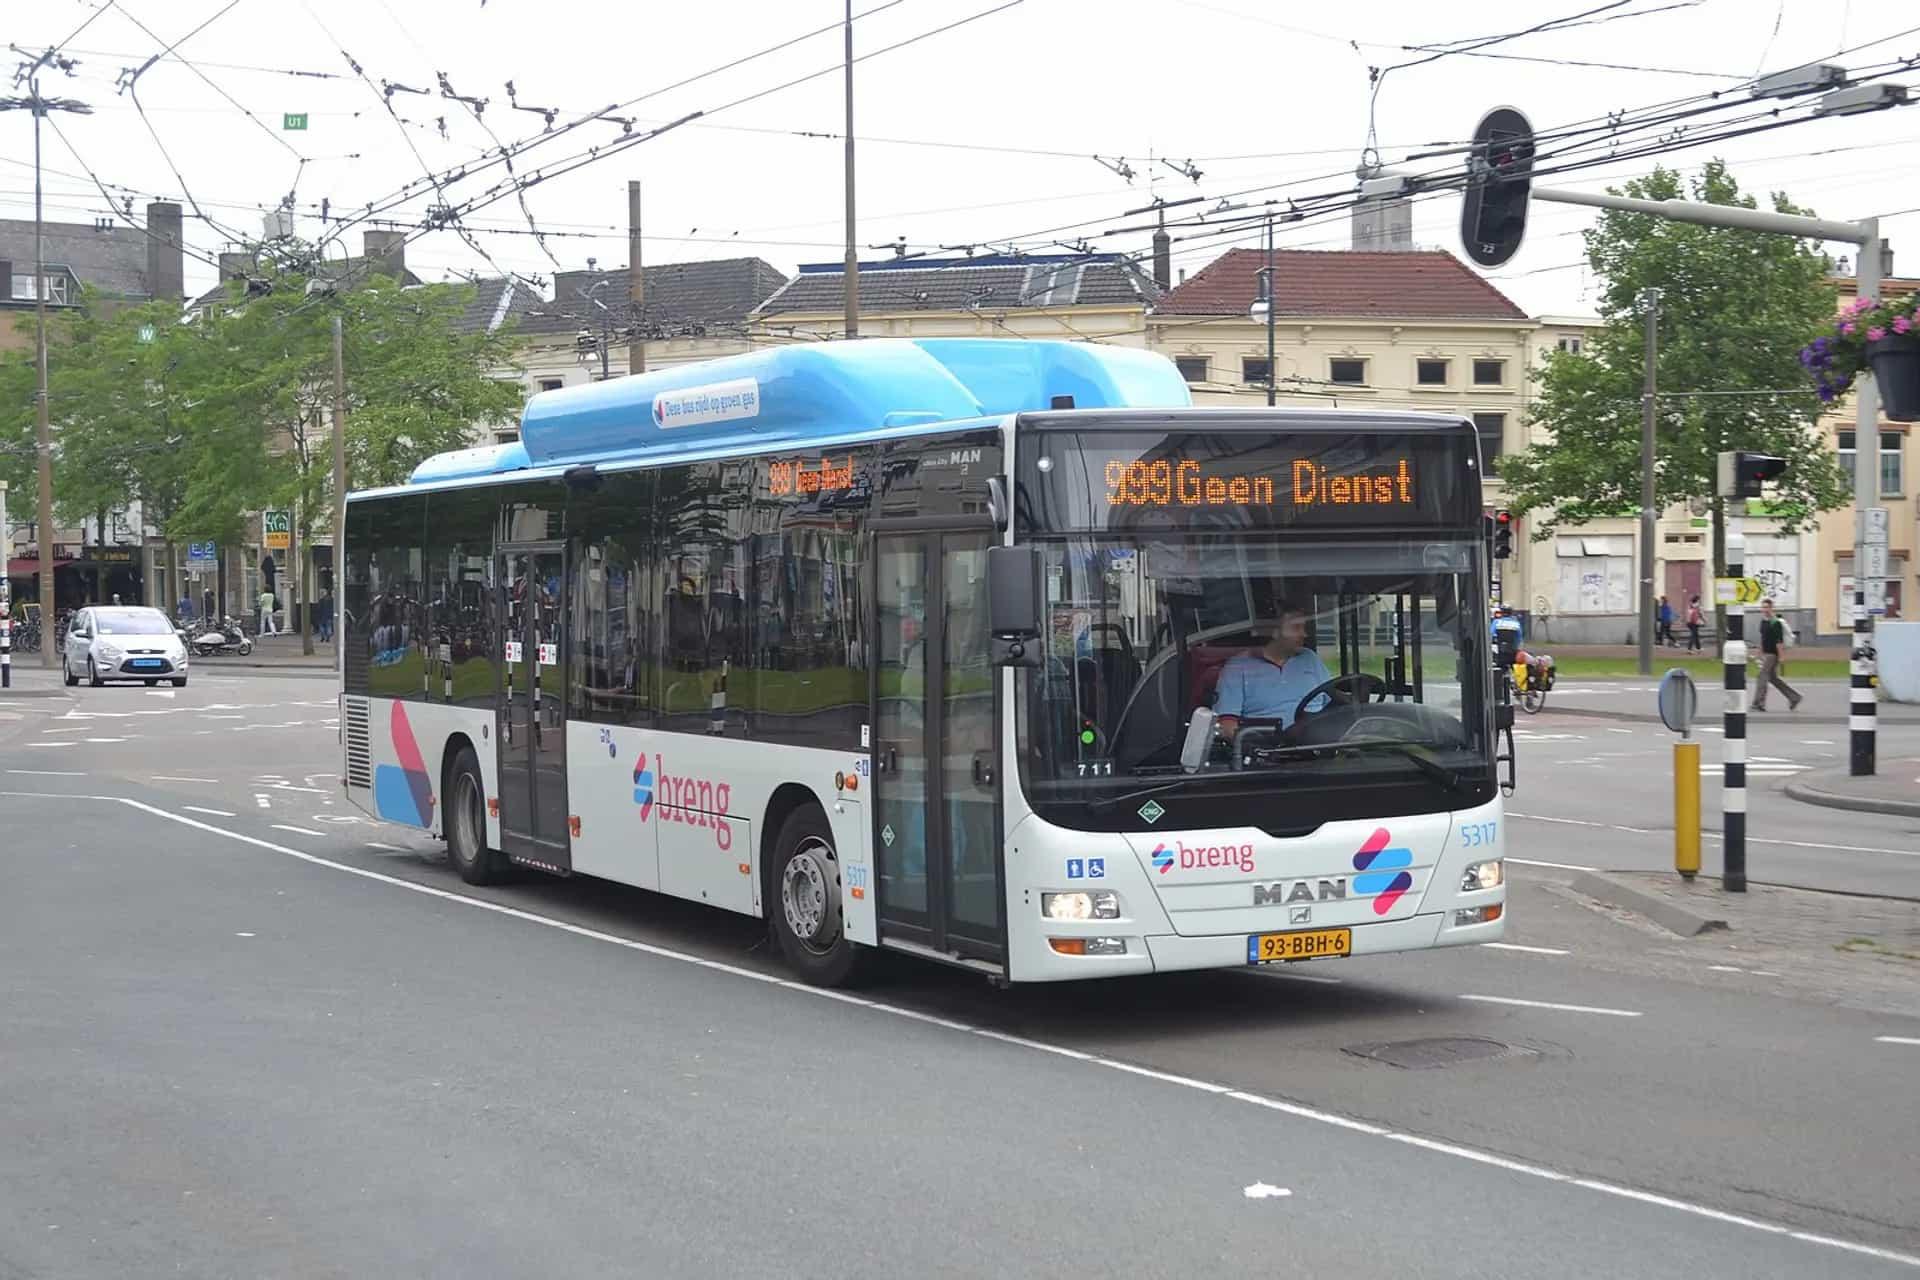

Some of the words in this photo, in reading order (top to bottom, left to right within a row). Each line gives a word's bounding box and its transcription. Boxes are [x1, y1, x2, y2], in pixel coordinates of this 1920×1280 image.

[951, 450, 980, 464] MAN
[1293, 458, 1412, 504] Dienst
[656, 754, 731, 850] breng
[1461, 822, 1497, 848] 5317
[1177, 841, 1255, 873] breng
[1254, 878, 1347, 906] MAN
[1264, 933, 1345, 956] 93-BBH-6
